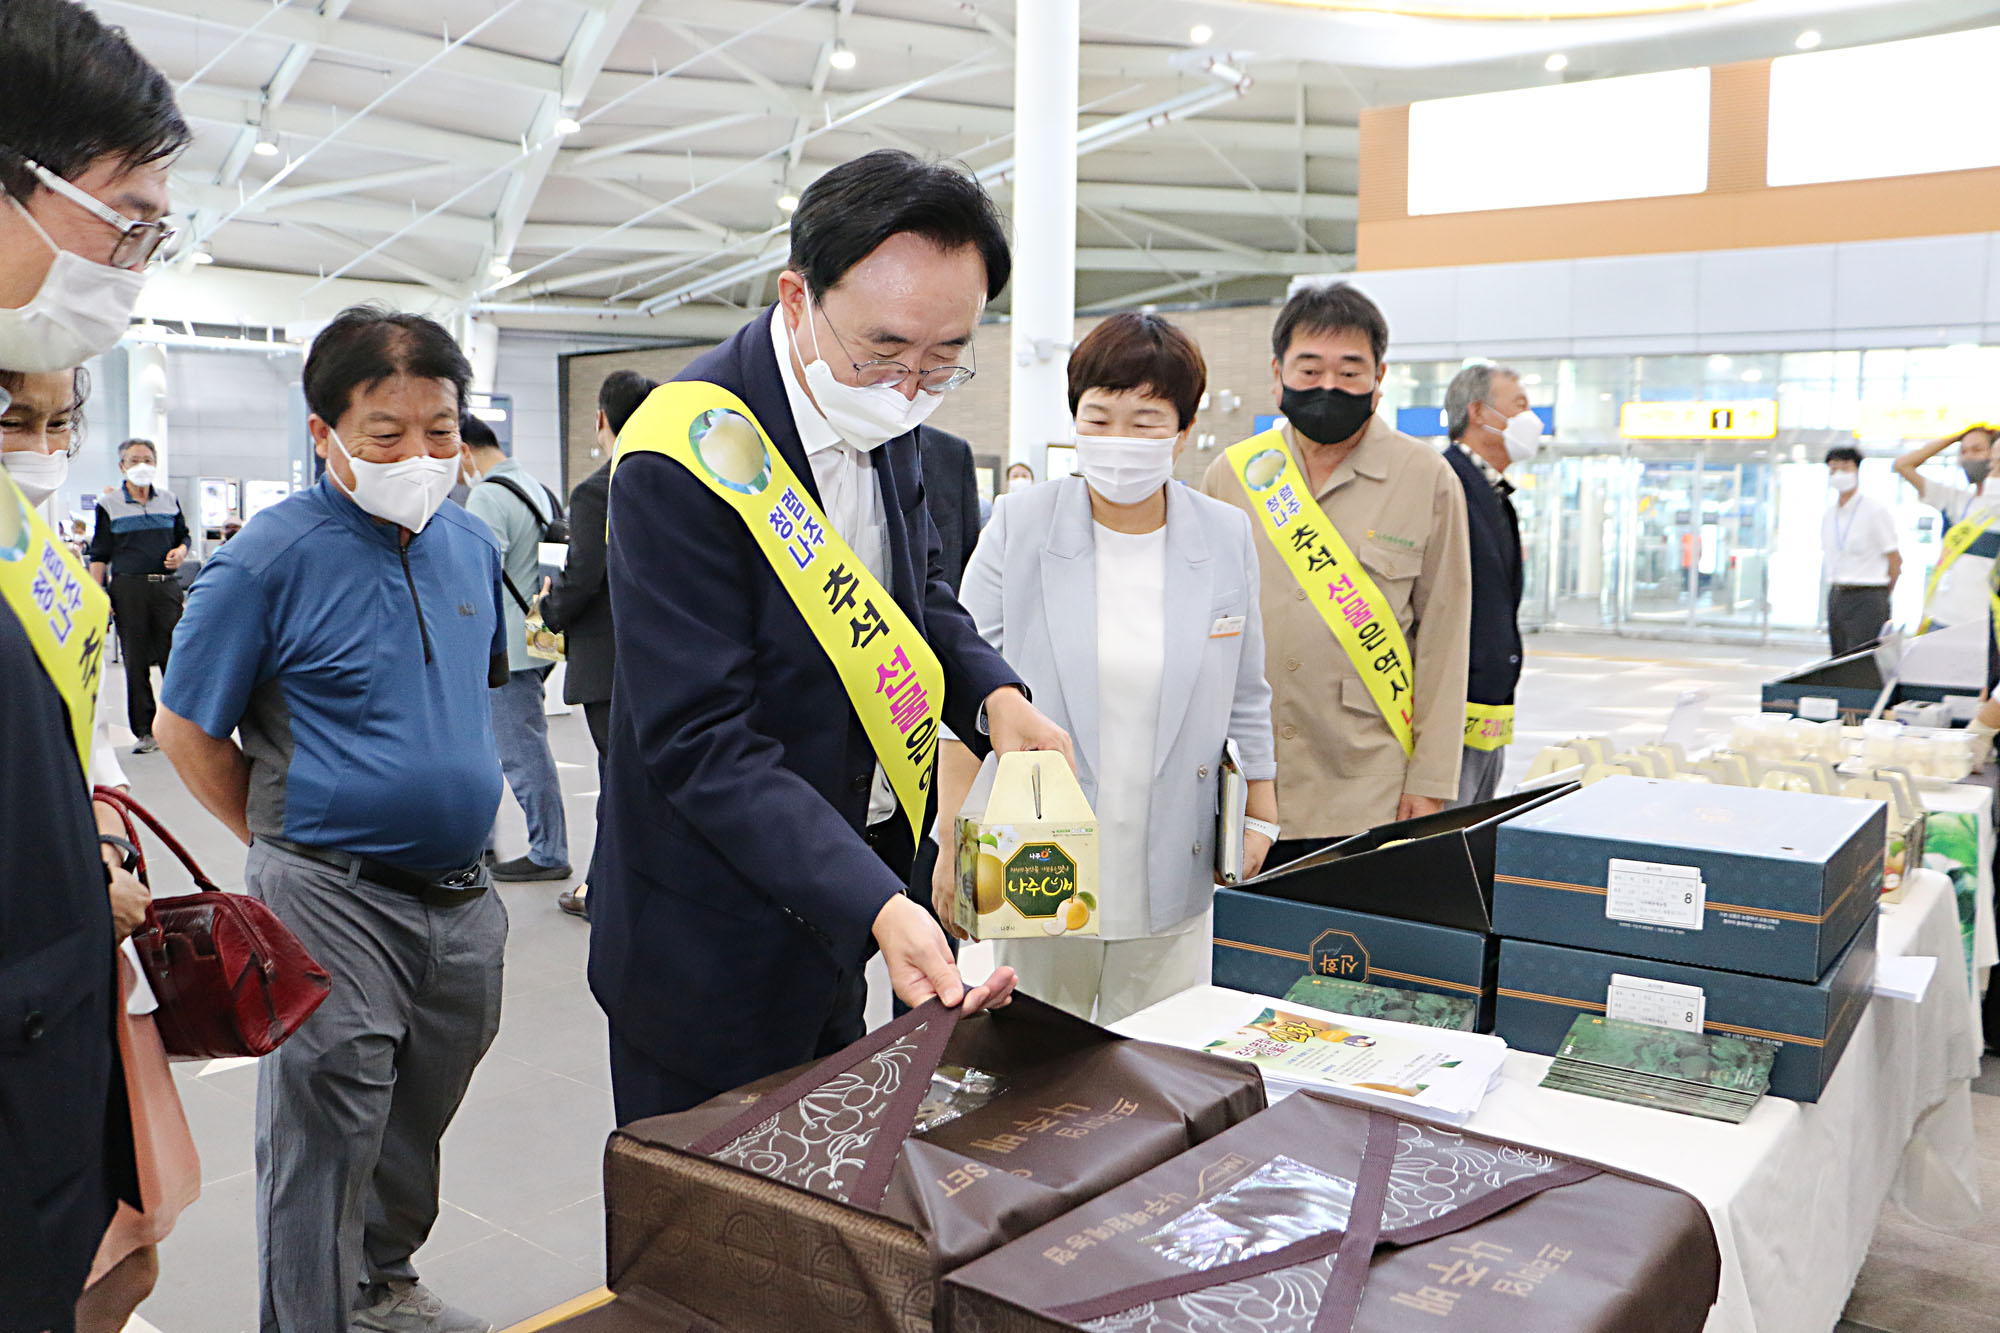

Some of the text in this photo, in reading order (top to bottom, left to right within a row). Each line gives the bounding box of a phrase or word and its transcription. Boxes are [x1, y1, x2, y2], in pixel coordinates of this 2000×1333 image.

[1715, 410, 1727, 429] 1
[768, 485, 807, 541] 청렴
[1265, 481, 1294, 513] 청렴
[1272, 496, 1302, 529] 나주
[787, 517, 826, 572] 나주
[30, 537, 65, 613] 청렴
[49, 570, 83, 647] 나주
[1291, 523, 1410, 702] 추석 선물은 역시
[822, 562, 939, 766] 추석 선물은
[1684, 892, 1693, 904] 8
[1319, 953, 1360, 974] 신화
[1685, 1011, 1693, 1023] 8
[970, 1102, 1091, 1154] 나주배
[1054, 1097, 1139, 1139] 프리미엄
[936, 1162, 989, 1197] SET
[1389, 1240, 1513, 1317] 나주배
[1491, 1243, 1573, 1298] 프리미엄
